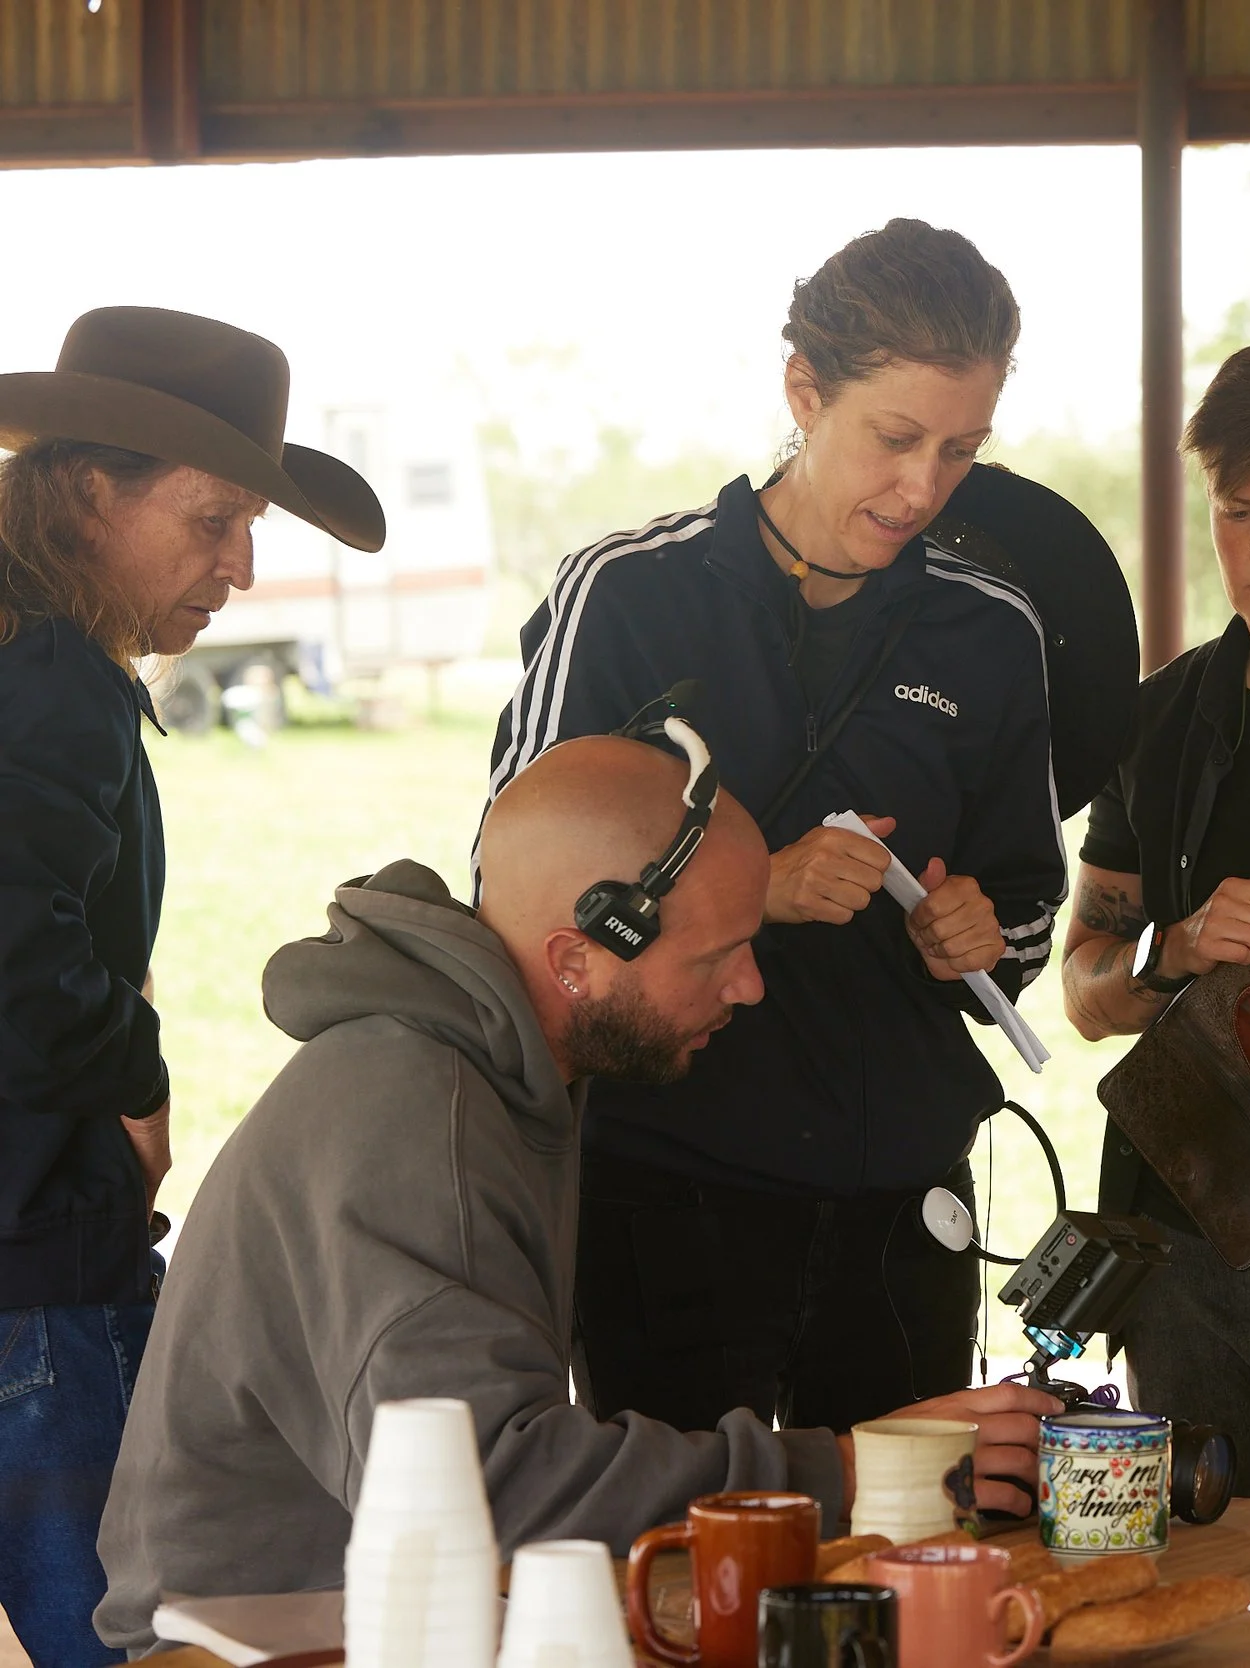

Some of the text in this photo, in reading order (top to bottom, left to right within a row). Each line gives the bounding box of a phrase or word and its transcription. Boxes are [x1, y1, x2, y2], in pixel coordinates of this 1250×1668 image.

[894, 684, 958, 717] adidas
[639, 898, 652, 913] 1
[604, 916, 642, 946] RYAN
[1050, 1455, 1162, 1485] Para mi
